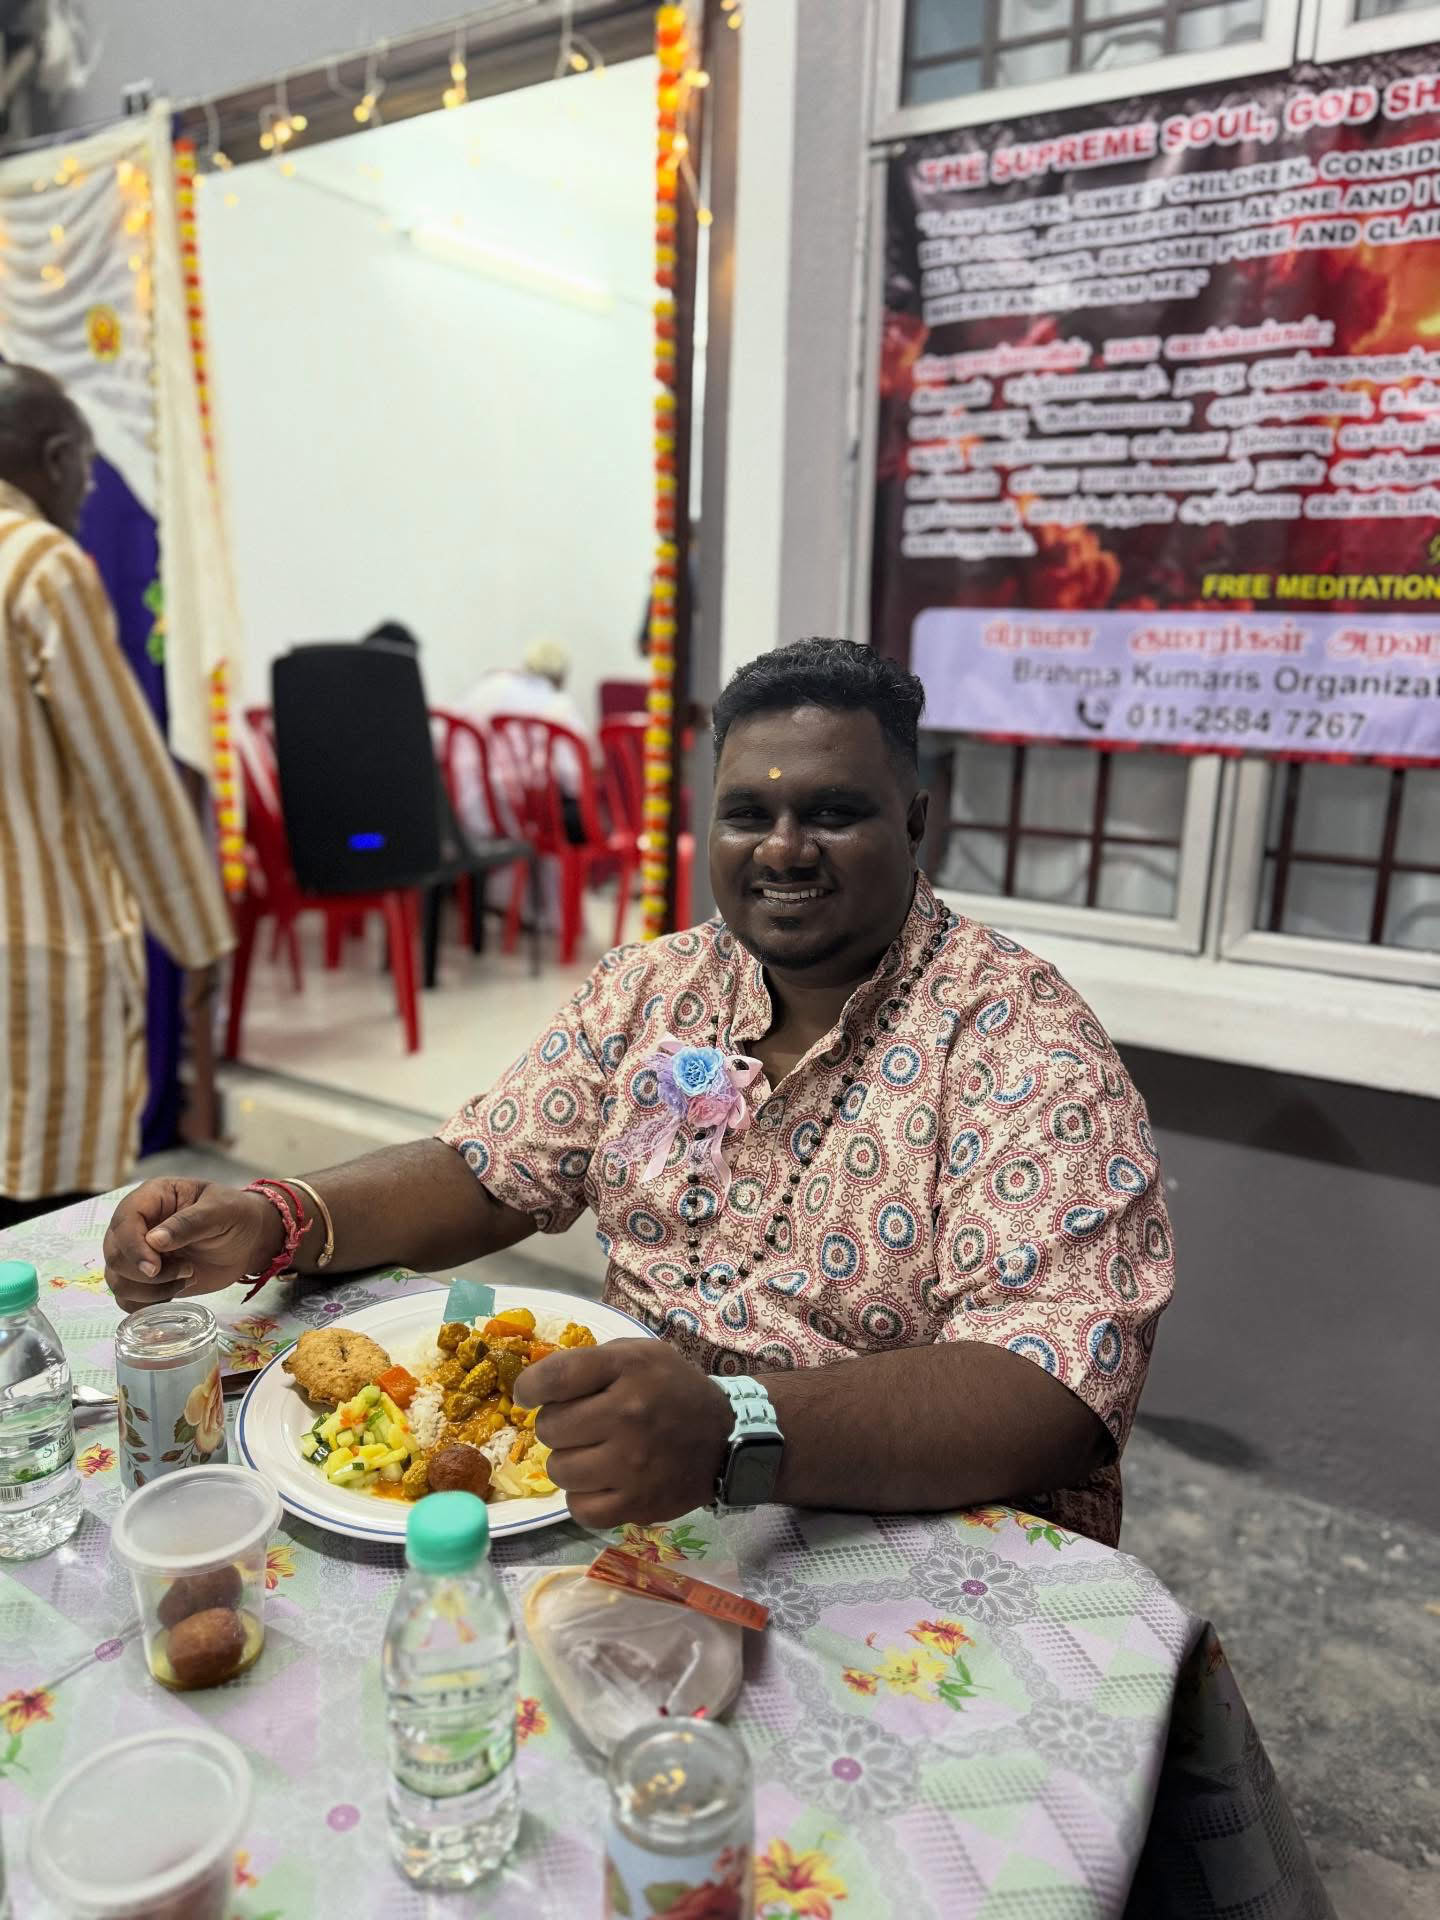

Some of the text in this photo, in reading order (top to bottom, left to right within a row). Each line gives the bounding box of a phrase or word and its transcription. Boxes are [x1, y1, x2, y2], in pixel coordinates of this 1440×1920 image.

[924, 158, 982, 185] THE
[992, 131, 1151, 178] SUPREME
[1166, 108, 1274, 147] SOUL,
[1289, 91, 1374, 127] GOD
[1324, 146, 1440, 176] CONSID
[1201, 206, 1235, 226] ME
[1246, 190, 1337, 218] ALONE
[1346, 186, 1407, 209] AND
[1221, 230, 1286, 254] PURE
[1299, 224, 1358, 246] AND
[1369, 214, 1440, 241] CLAI
[1202, 574, 1440, 600] FREE MEDITATION
[1013, 658, 1121, 685] Brahma
[1132, 662, 1260, 691] Kumaris
[1126, 703, 1366, 739] 011-2584 7267
